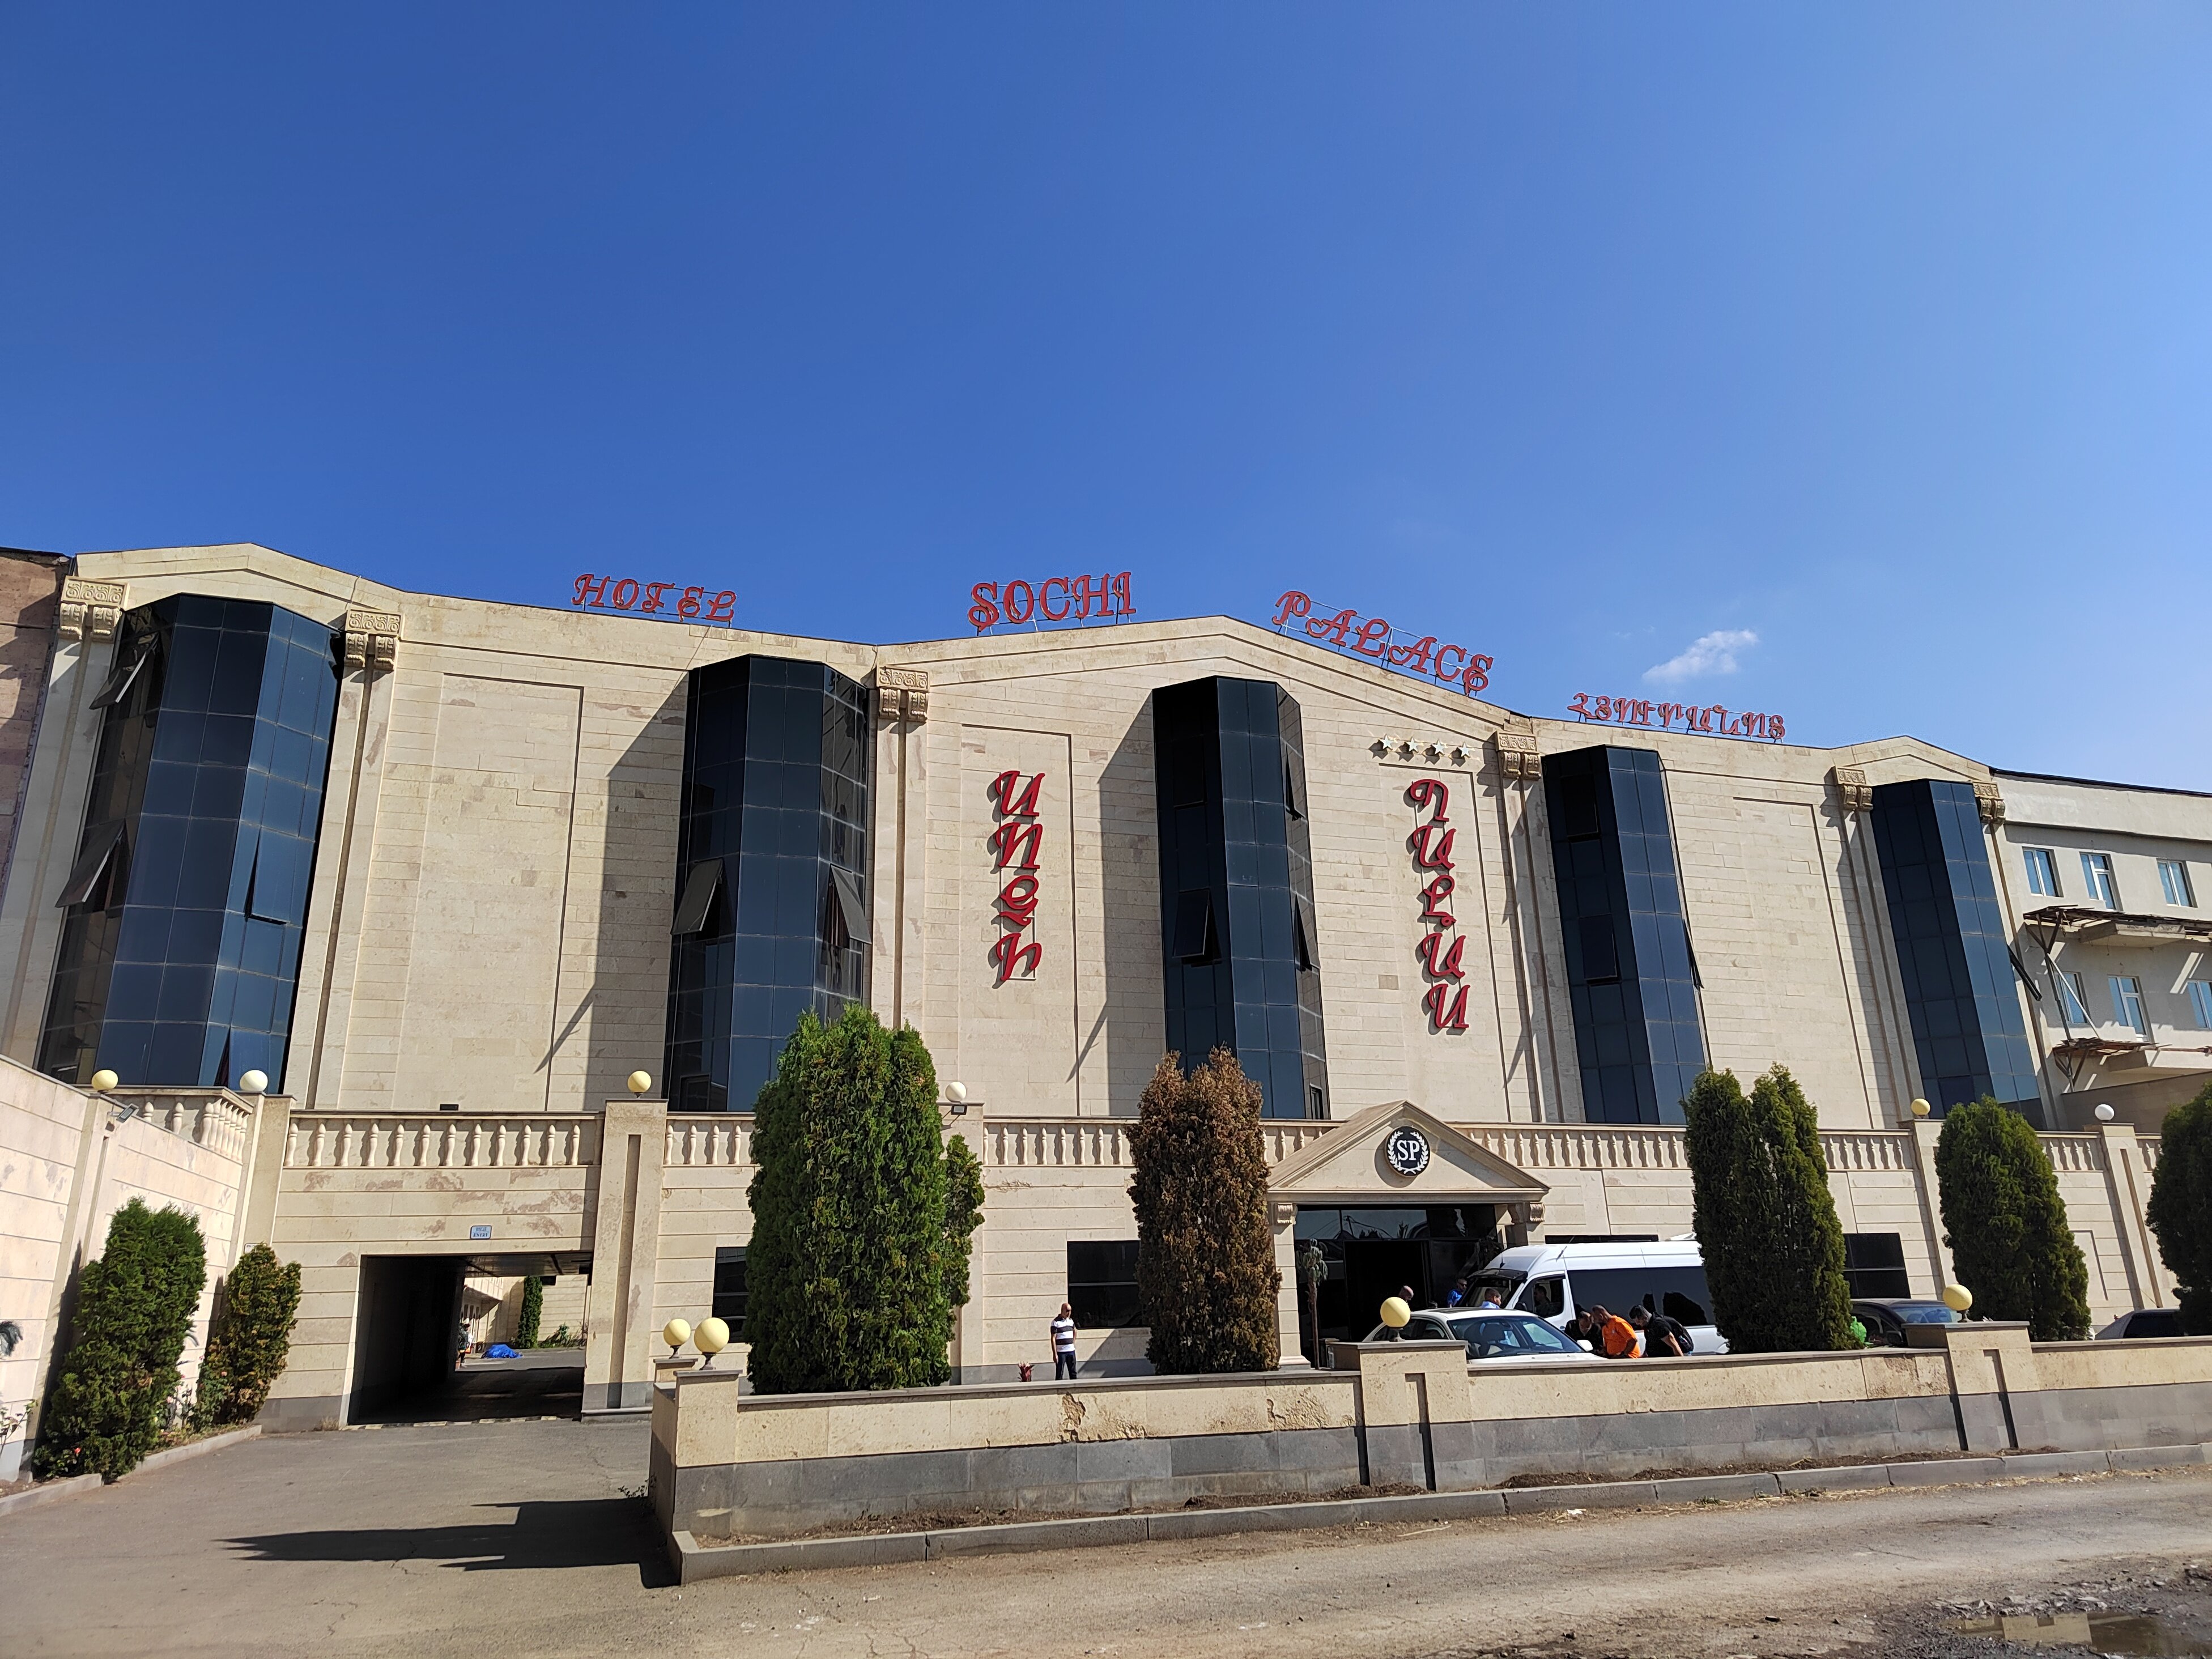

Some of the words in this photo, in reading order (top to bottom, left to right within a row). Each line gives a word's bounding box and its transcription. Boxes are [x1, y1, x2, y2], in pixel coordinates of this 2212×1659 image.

[572, 574, 736, 622] HOTEL
[968, 571, 1136, 632] SOCHI
[1272, 591, 1494, 695] PALACE
[1567, 692, 1785, 740] ՀՅՈՒՐԱՆՈՑ
[1397, 1139, 1420, 1161] SP
